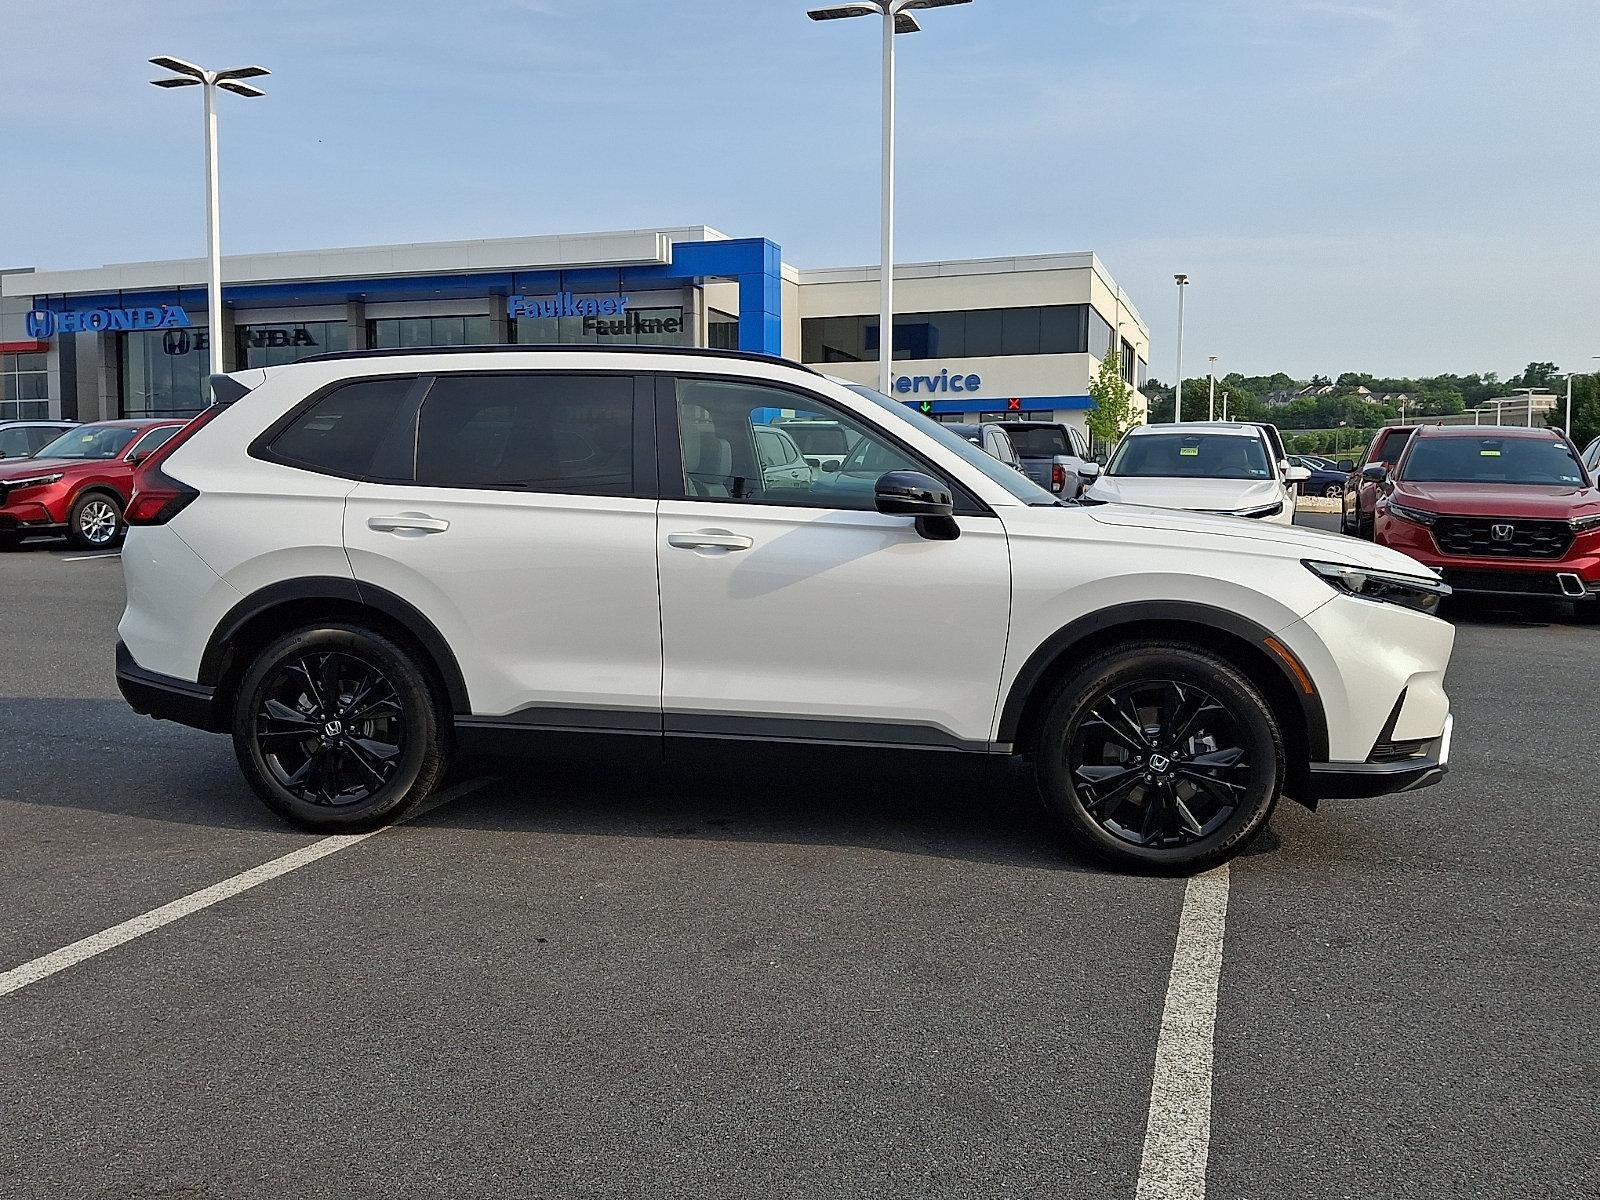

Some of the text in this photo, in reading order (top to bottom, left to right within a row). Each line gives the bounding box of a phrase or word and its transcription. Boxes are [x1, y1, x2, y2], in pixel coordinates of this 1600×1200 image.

[57, 304, 192, 332] HONDA
[507, 291, 628, 319] Faulkner
[890, 368, 981, 394] ervice
